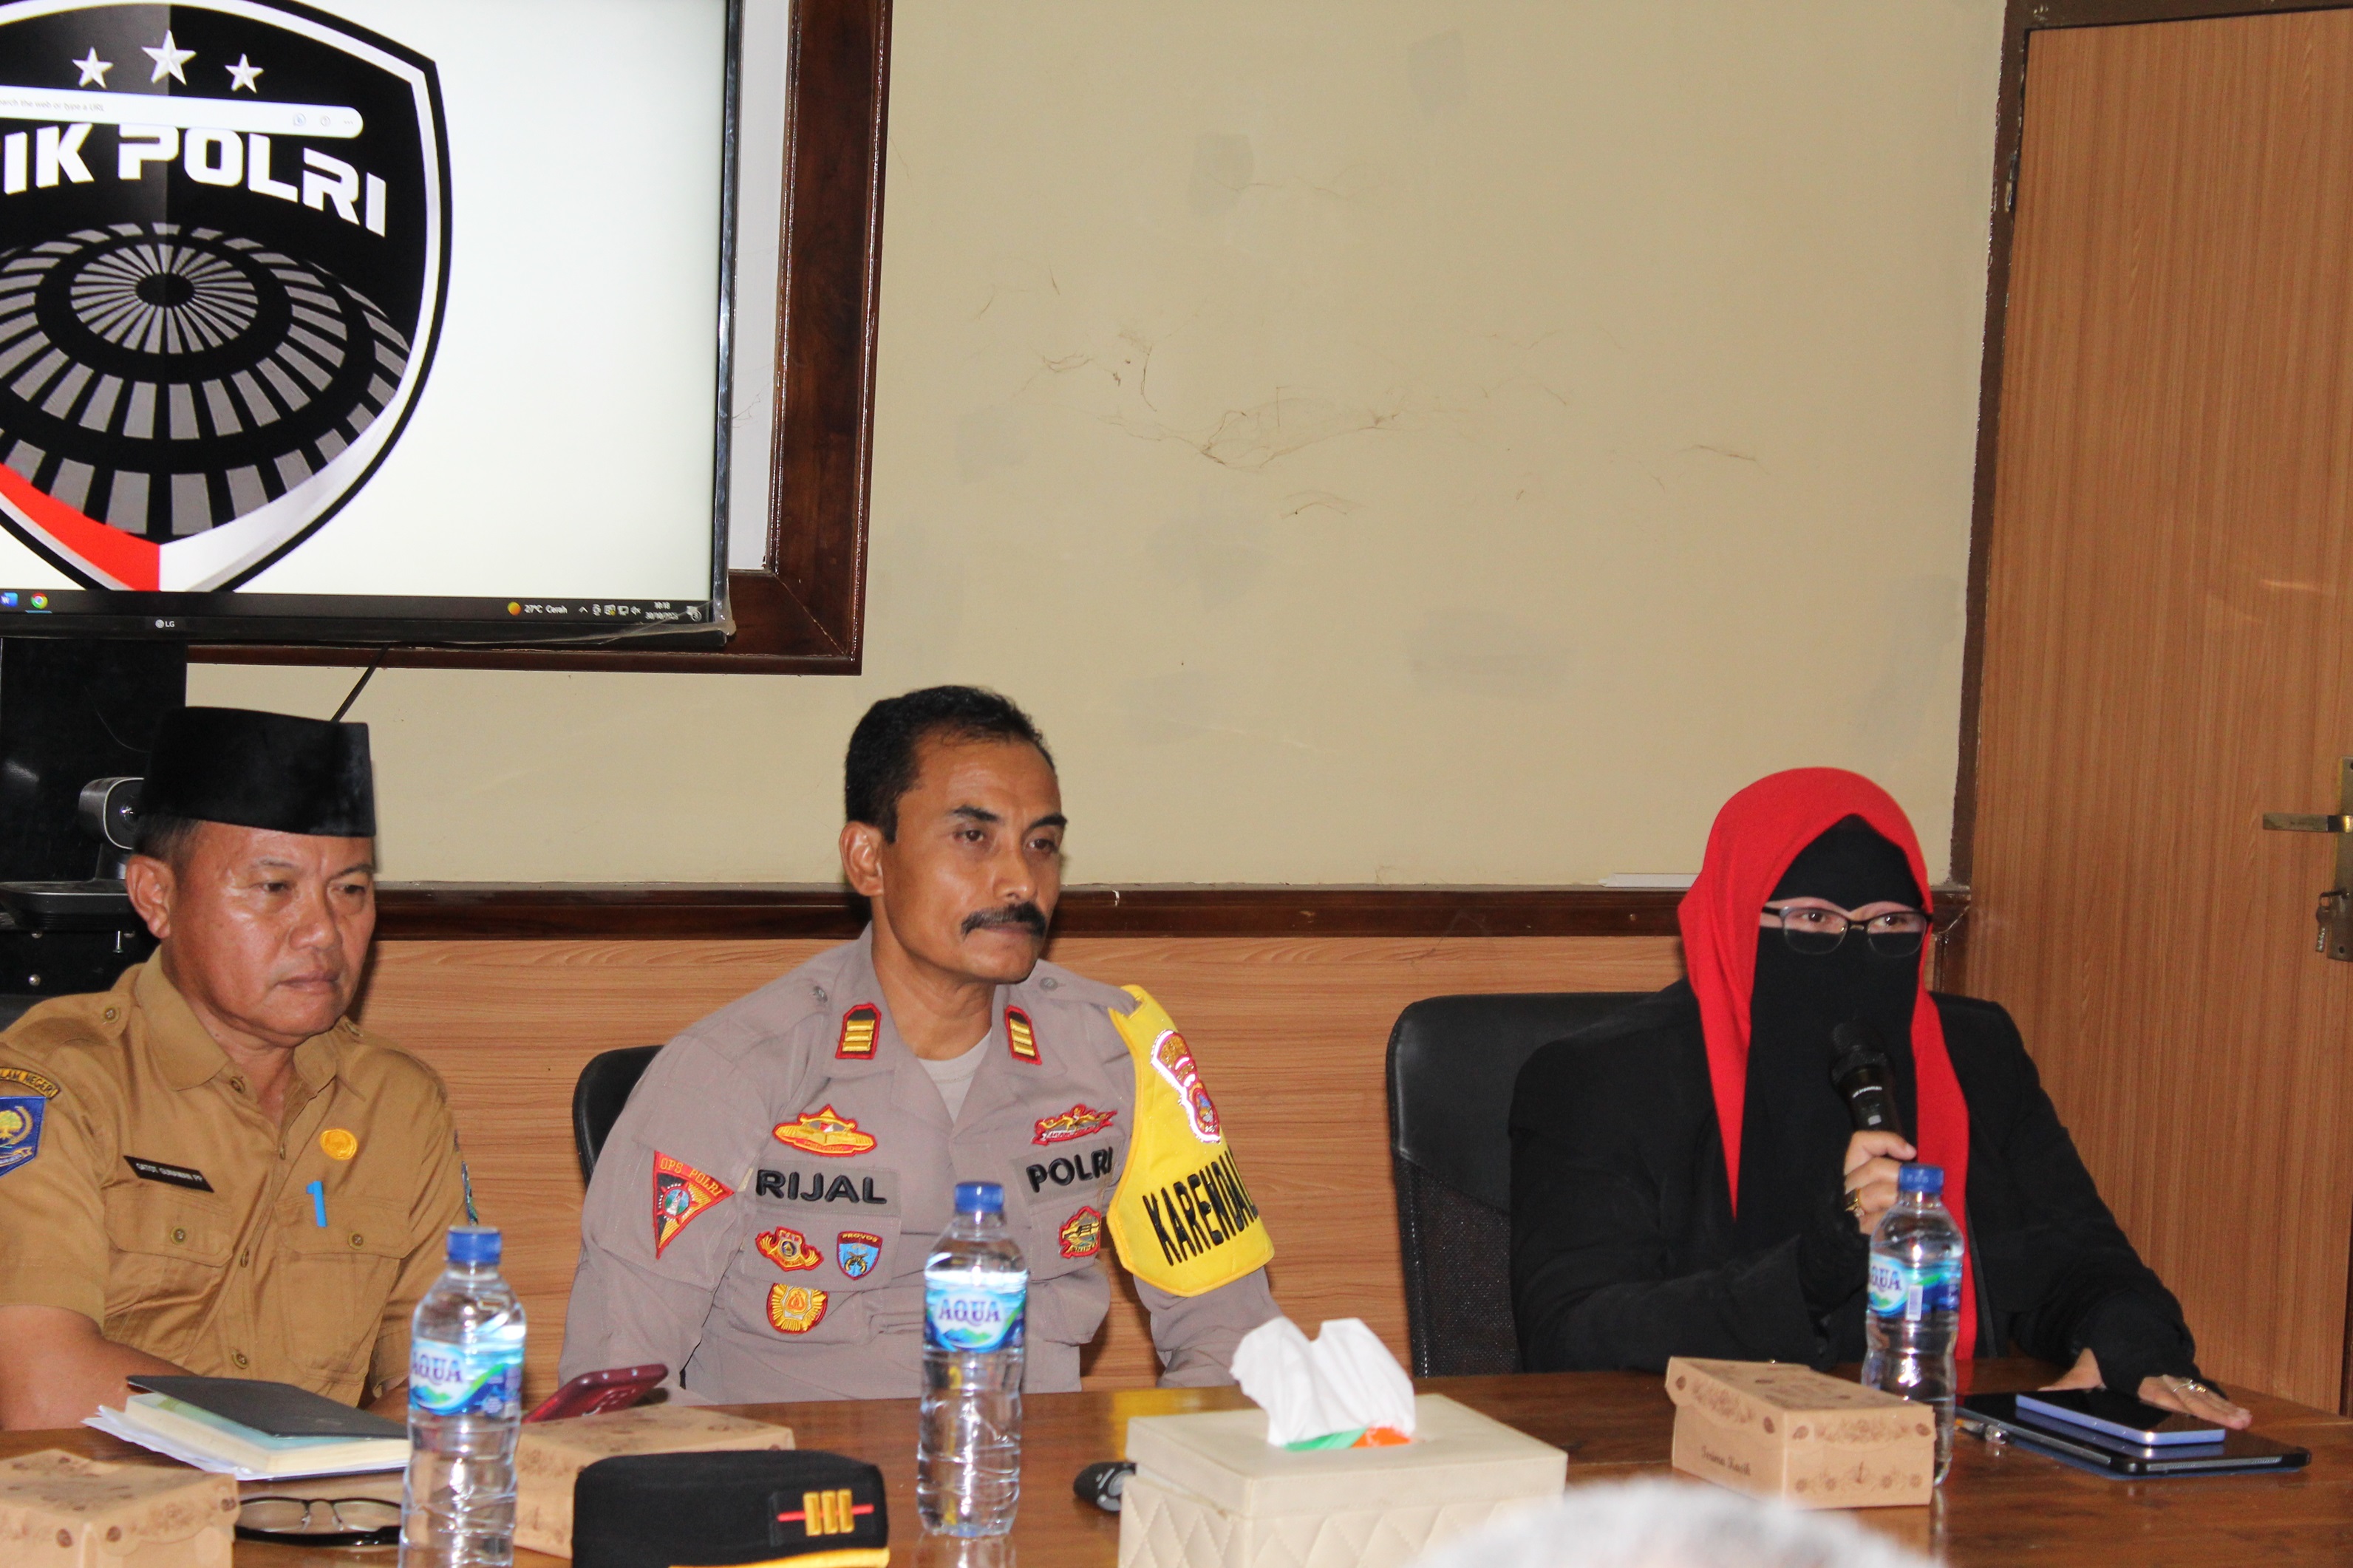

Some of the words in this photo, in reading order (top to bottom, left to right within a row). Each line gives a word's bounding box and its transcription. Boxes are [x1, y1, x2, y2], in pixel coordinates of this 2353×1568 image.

[118, 123, 387, 238] POLRI
[659, 1157, 684, 1174] OPS
[687, 1168, 723, 1198] POLRI
[755, 1168, 888, 1205] RIJAL
[1026, 1146, 1114, 1193] POLRI
[1869, 1264, 1902, 1292] QUA
[939, 1298, 1001, 1327] AQUA
